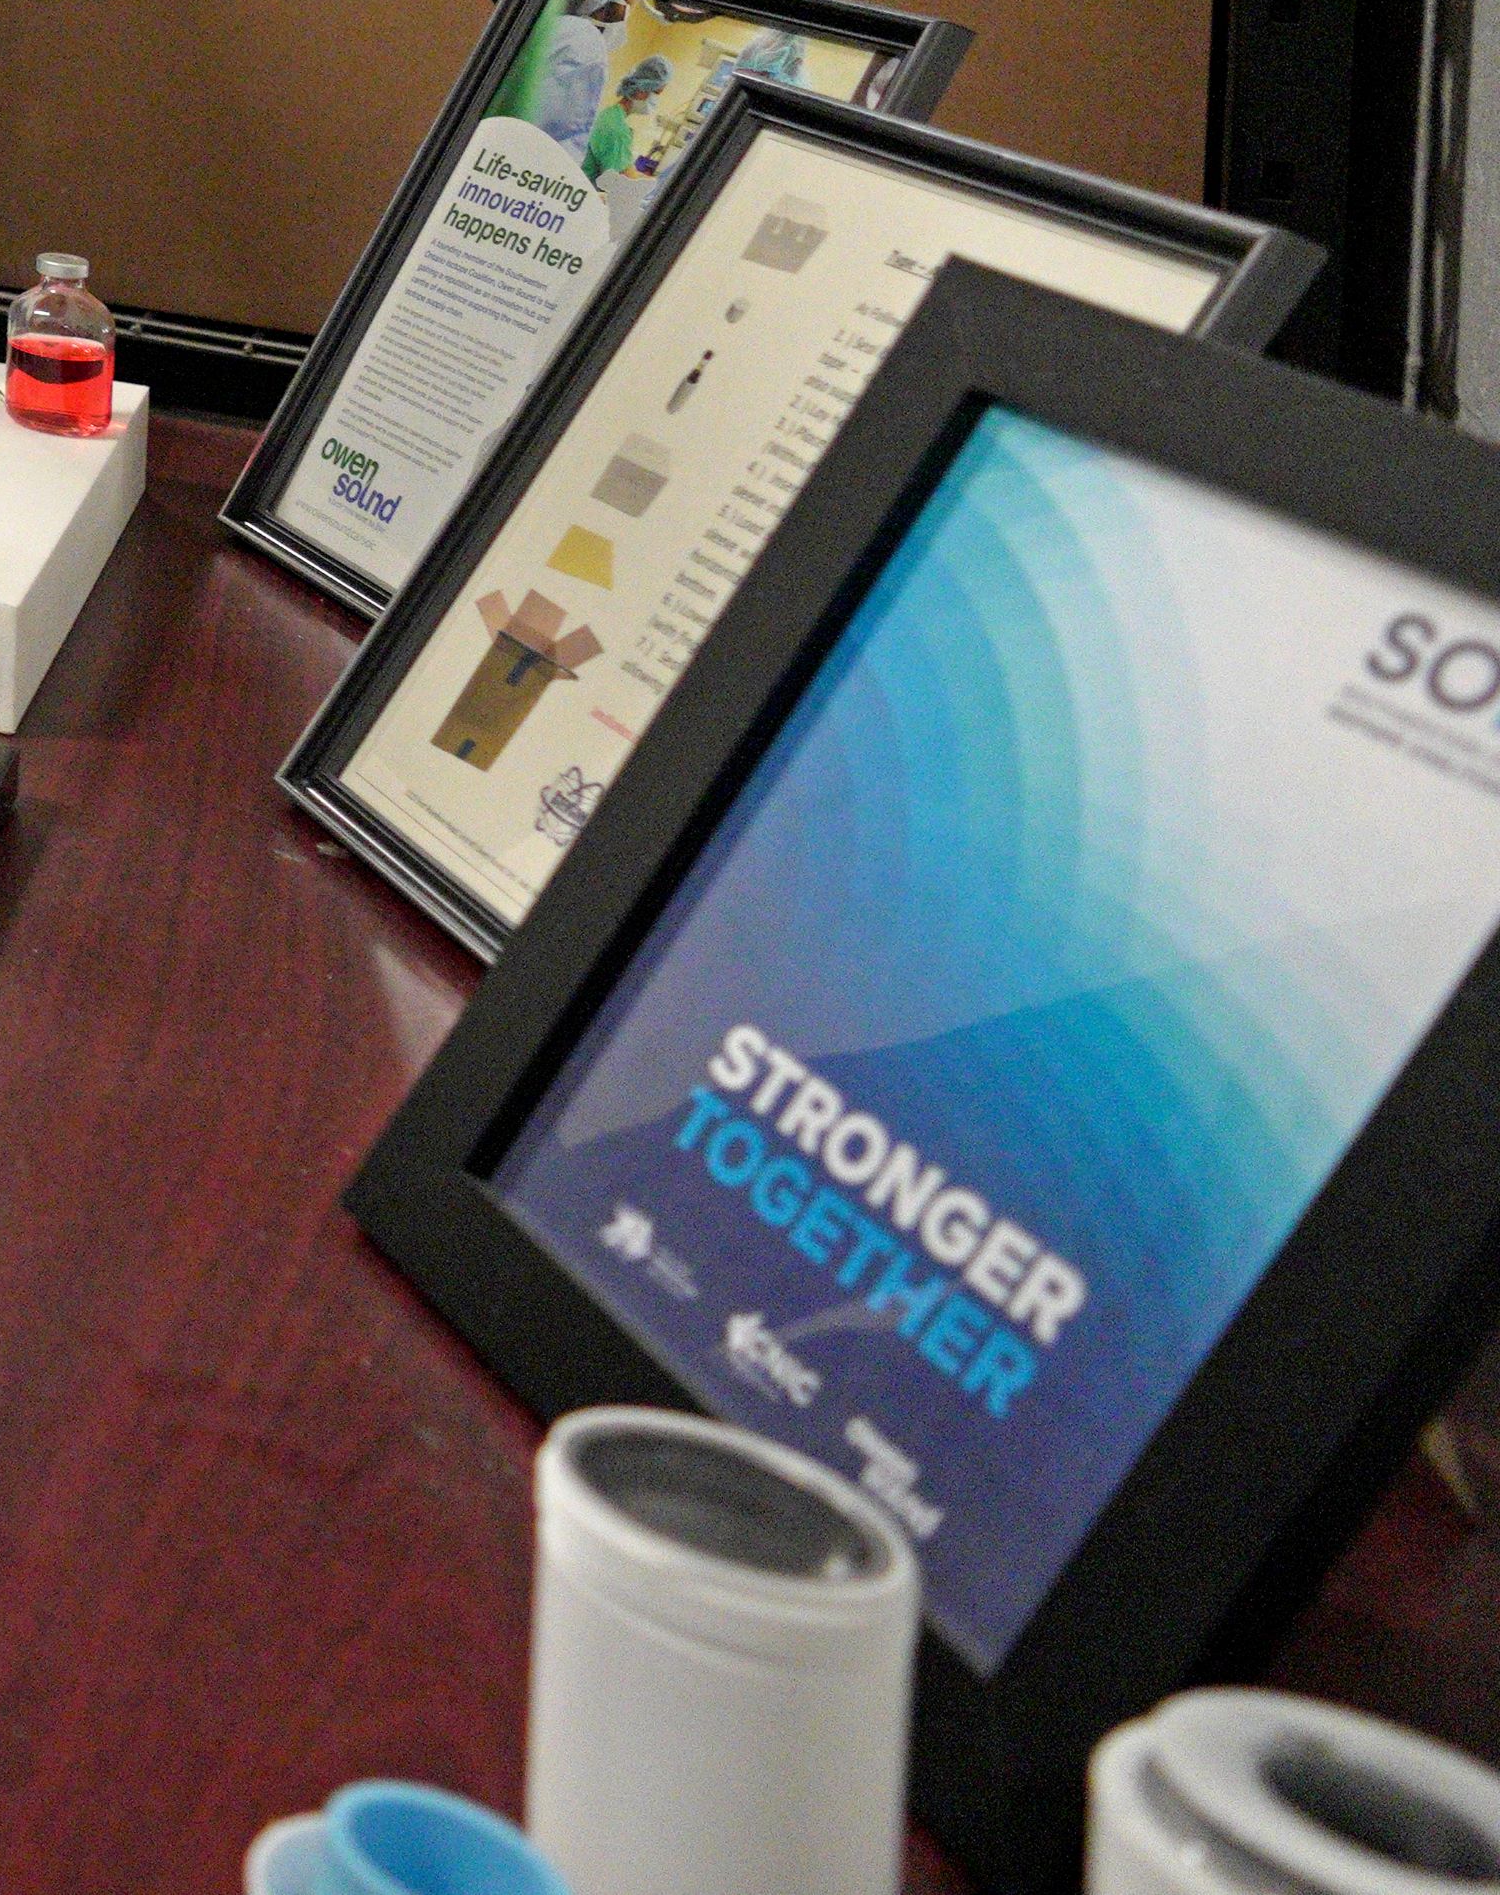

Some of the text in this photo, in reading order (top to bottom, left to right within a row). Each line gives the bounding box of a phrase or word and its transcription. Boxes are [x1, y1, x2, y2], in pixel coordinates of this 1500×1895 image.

[458, 176, 565, 233] innovation
[473, 148, 588, 212] Life-saving
[443, 203, 583, 275] happens here
[321, 438, 379, 482] owen
[334, 473, 402, 524] sound
[709, 1025, 1086, 1344] STRONGER
[674, 1085, 1036, 1418] TOGETHER
